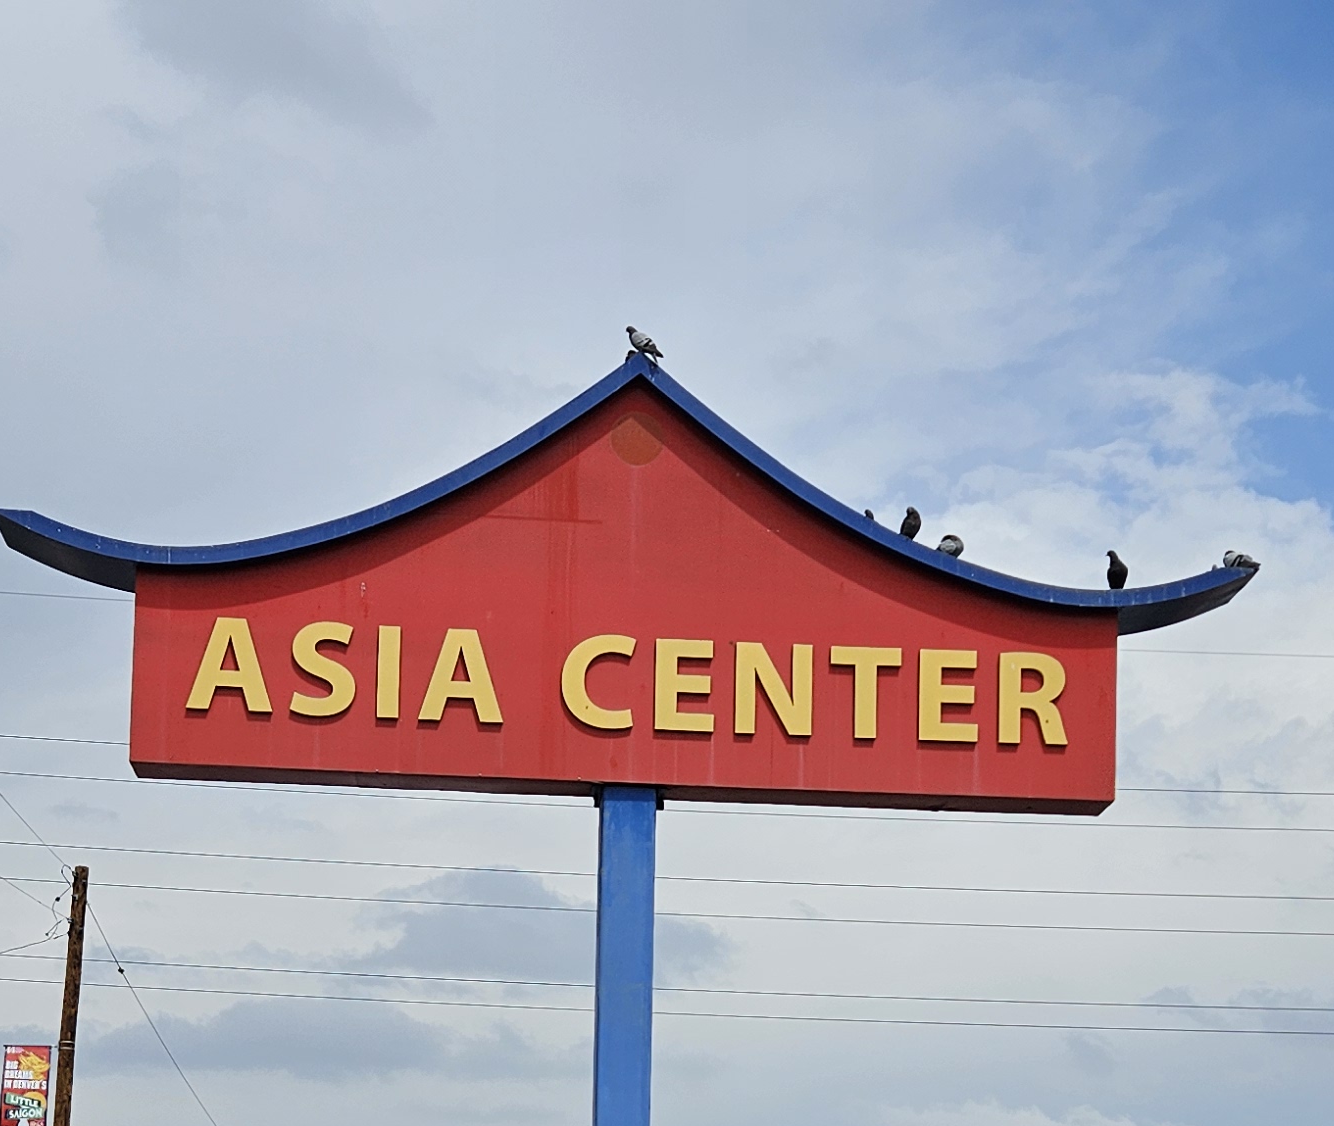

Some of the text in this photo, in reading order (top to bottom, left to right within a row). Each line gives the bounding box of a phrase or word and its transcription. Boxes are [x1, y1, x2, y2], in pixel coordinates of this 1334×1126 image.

[185, 617, 1068, 747] ASIA CENTER
[10, 1094, 39, 1107] LITTLE
[9, 1108, 43, 1119] SAIGON
